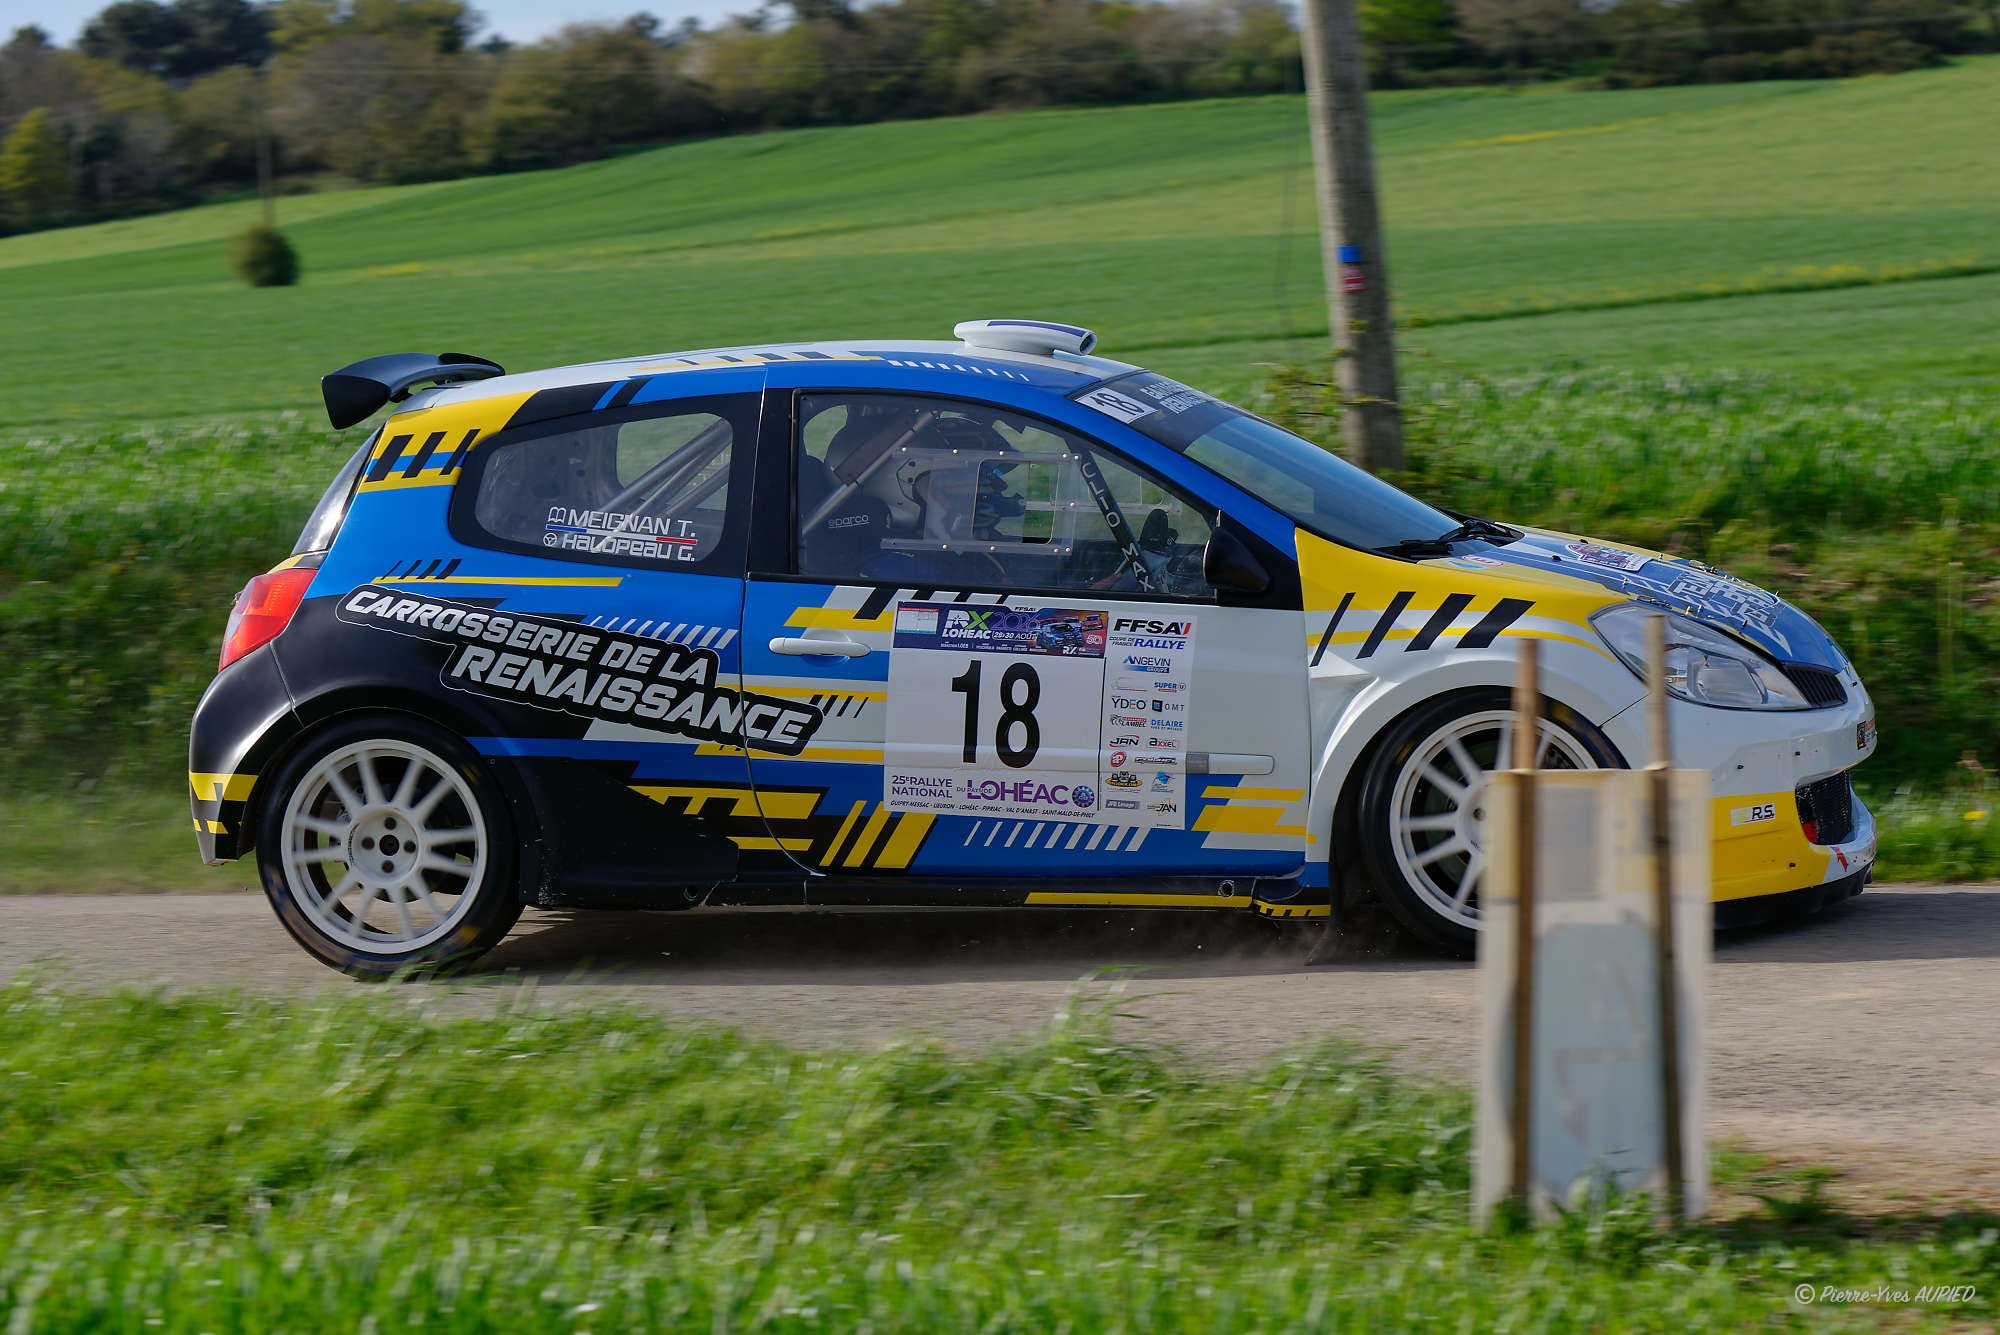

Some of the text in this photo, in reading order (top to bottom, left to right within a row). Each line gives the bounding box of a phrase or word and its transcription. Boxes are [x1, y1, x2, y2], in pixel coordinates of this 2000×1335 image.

[1089, 392, 1145, 416] 18
[568, 509, 696, 538] MEIGNAN T.
[1082, 462, 1155, 592] CLIO MAX
[678, 546, 695, 562] G.
[942, 629, 993, 639] LOHEAC
[1114, 618, 1182, 635] FFSA
[345, 591, 708, 684] CARROSSERIE DE LA
[1134, 638, 1186, 650] RALLYE
[1122, 656, 1170, 666] ANGEVIN
[451, 648, 812, 744] RENAISSANCE
[1112, 698, 1146, 710] YDEO
[952, 660, 1040, 768] 18
[1152, 720, 1183, 728] DELAIRE
[910, 776, 952, 788] RALLYE
[892, 786, 952, 798] NATIONAL
[968, 780, 1069, 805] LOHÉAC
